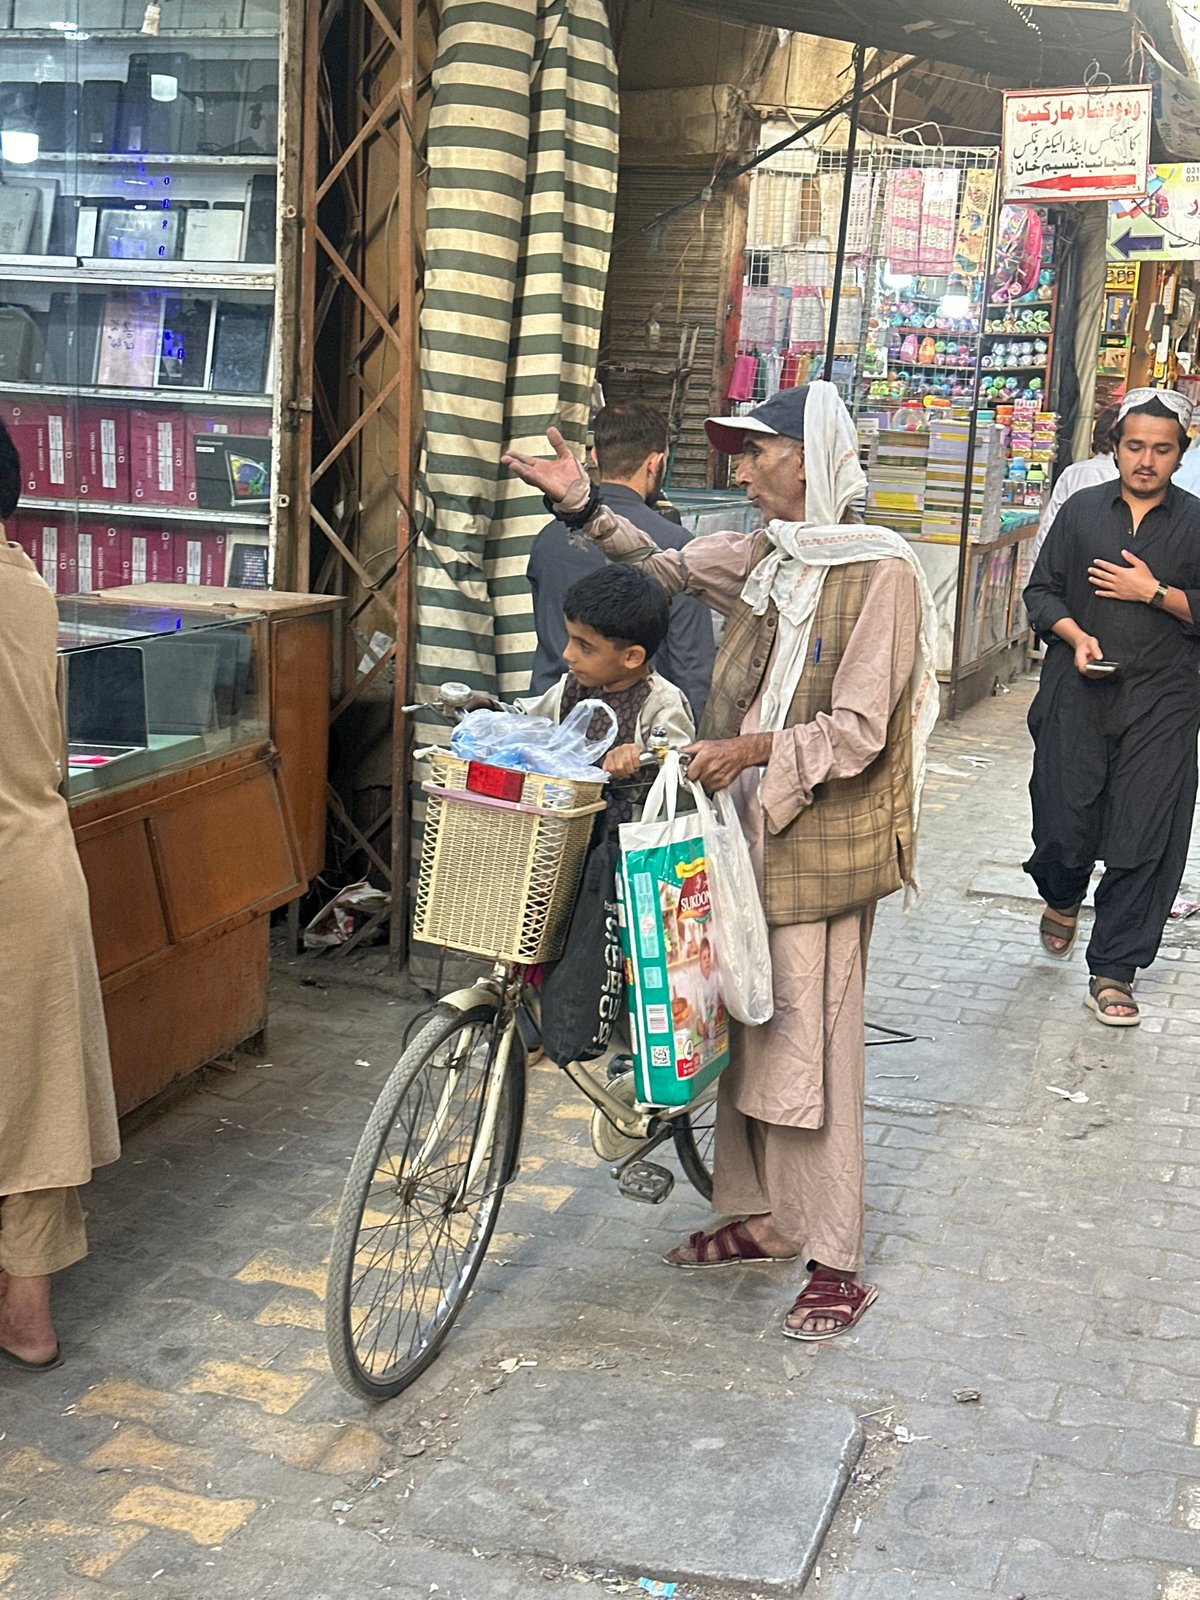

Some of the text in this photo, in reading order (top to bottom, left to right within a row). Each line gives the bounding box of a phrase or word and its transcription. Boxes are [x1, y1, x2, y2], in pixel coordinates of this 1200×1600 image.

[1016, 100, 1074, 127] مارکیٹ
[1016, 160, 1041, 175] خان
[1042, 157, 1080, 175] نسیم
[687, 1041, 693, 1057] 4
